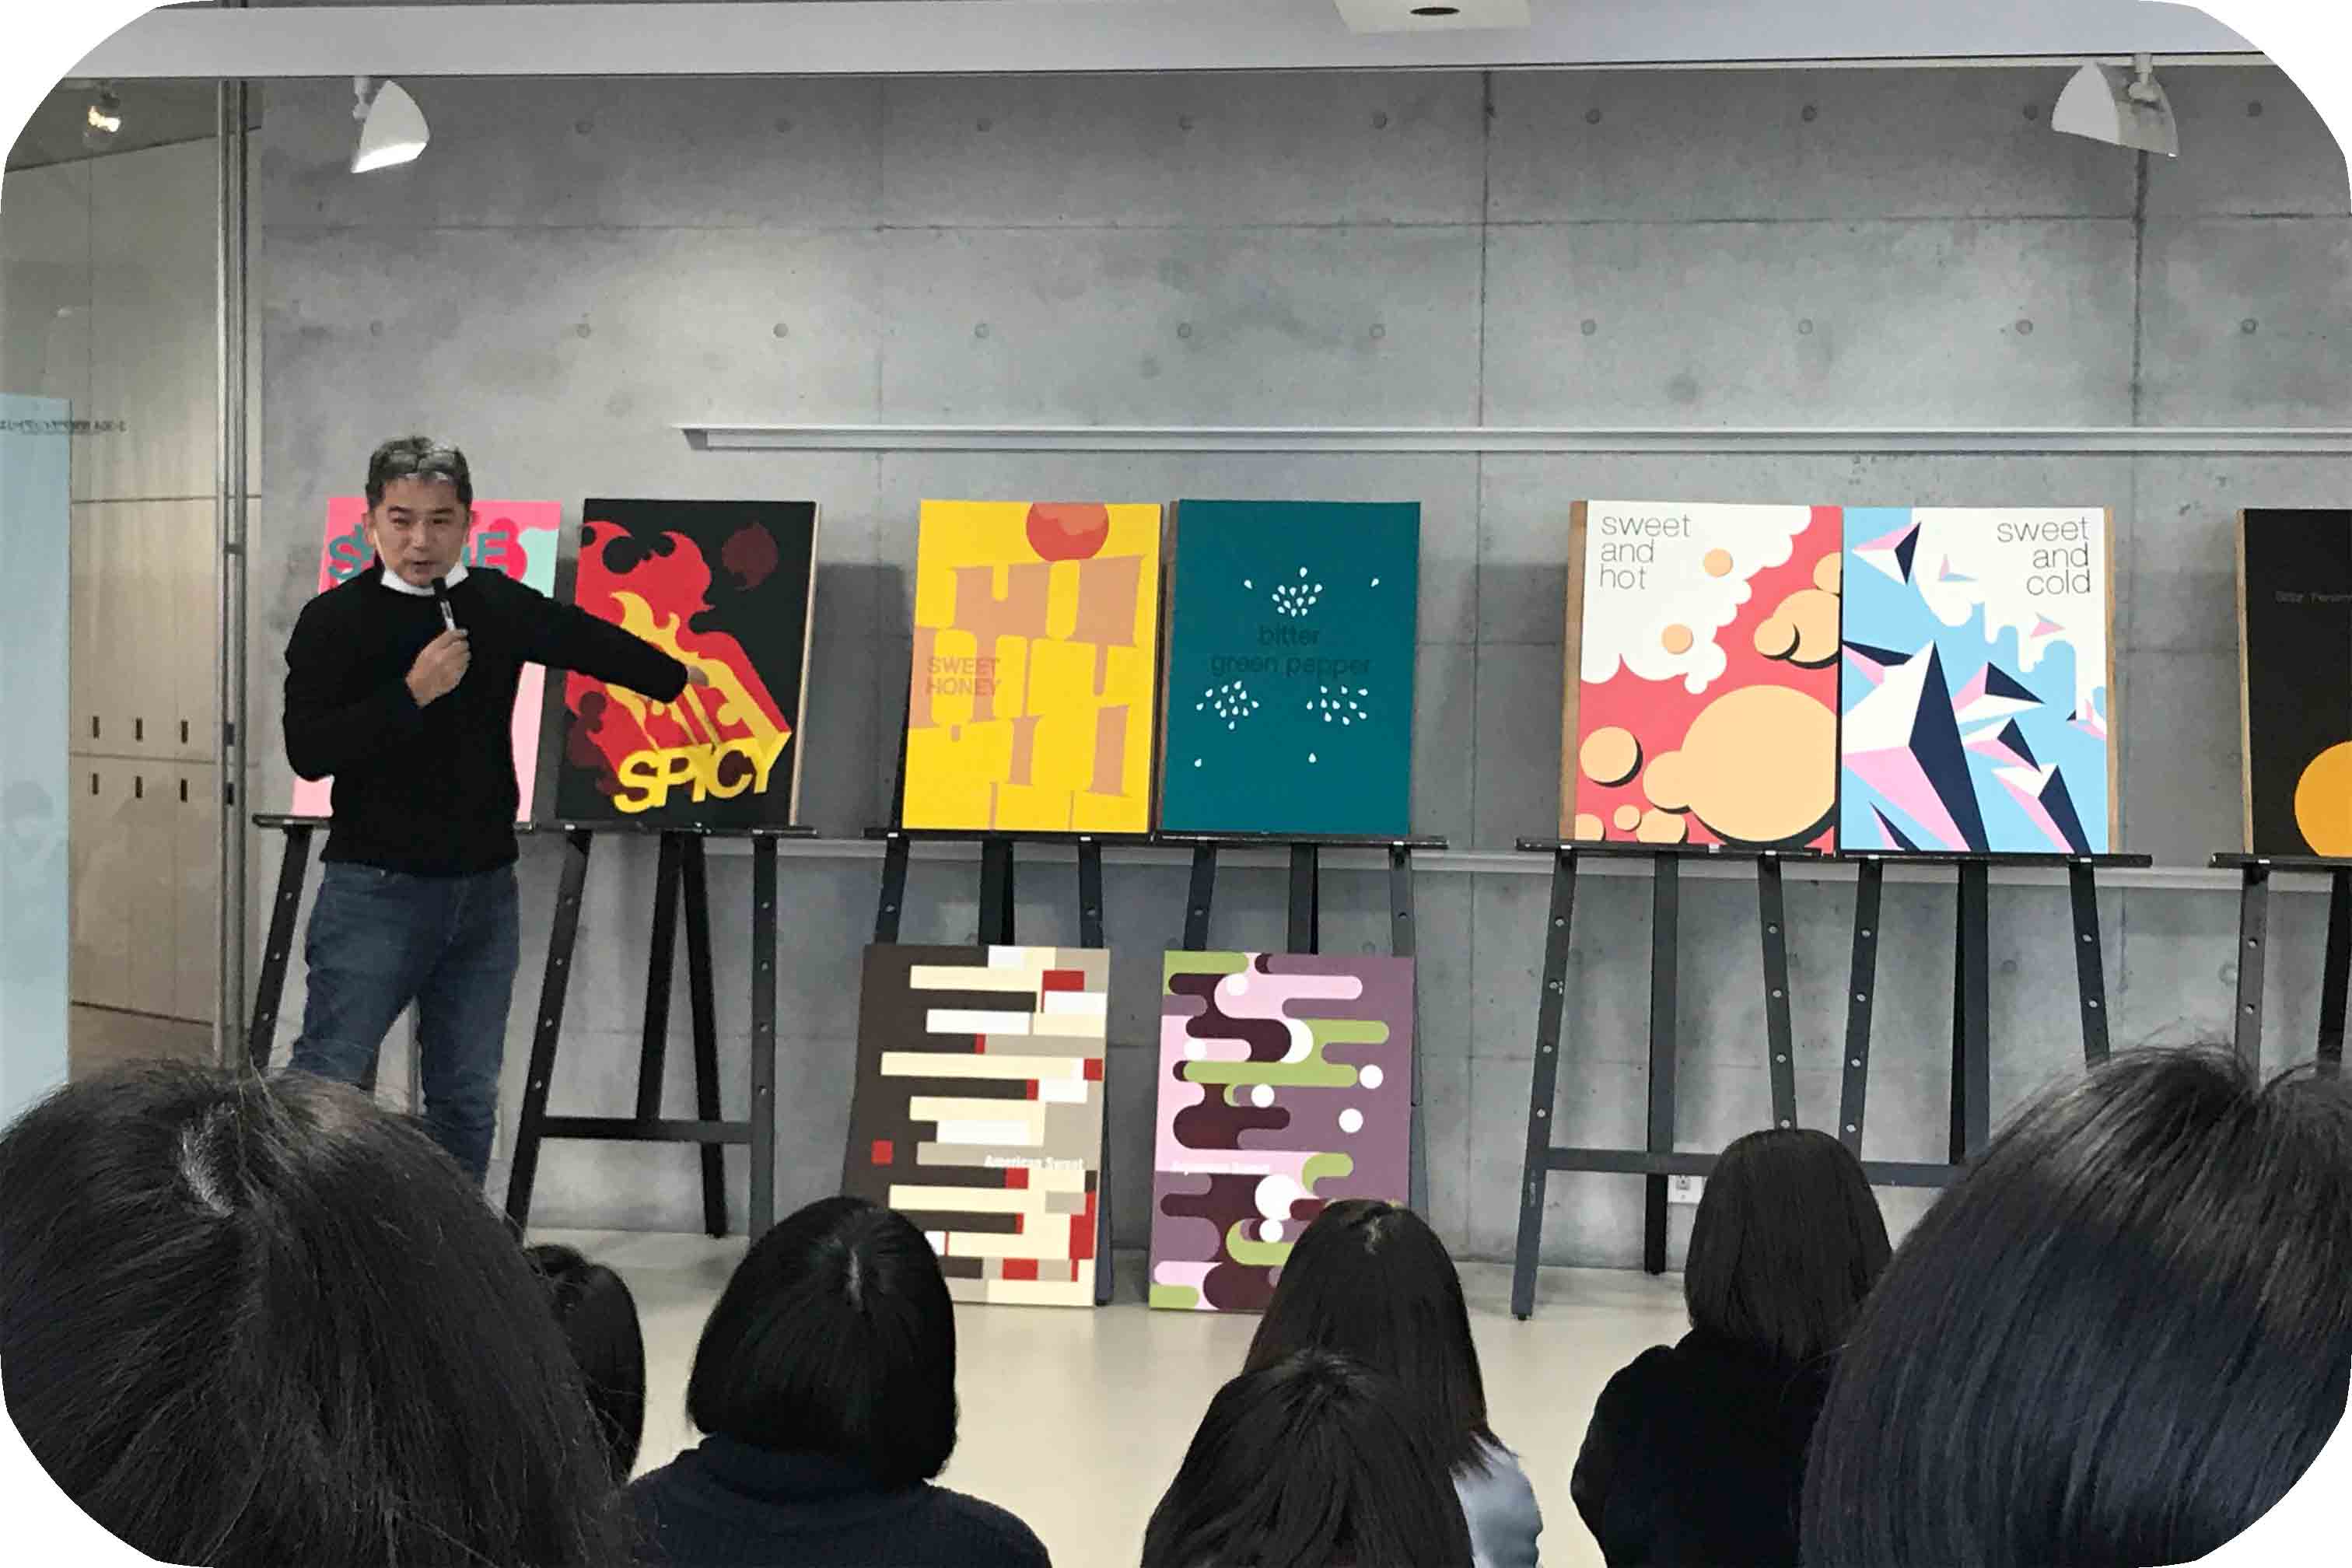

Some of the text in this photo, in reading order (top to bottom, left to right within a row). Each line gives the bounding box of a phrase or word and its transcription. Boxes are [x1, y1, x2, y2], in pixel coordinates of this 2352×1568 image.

[1601, 513, 1691, 537] sweet
[1997, 516, 2090, 543] sweet
[1601, 538, 1654, 563] and
[2032, 541, 2088, 569] and
[1599, 563, 1646, 590] hot
[2026, 569, 2091, 596] cold
[1258, 623, 1319, 645] bitter
[927, 657, 1000, 674] SWEET
[1210, 656, 1278, 676] green
[926, 677, 1001, 696] HONEY
[614, 732, 792, 814] SPICY
